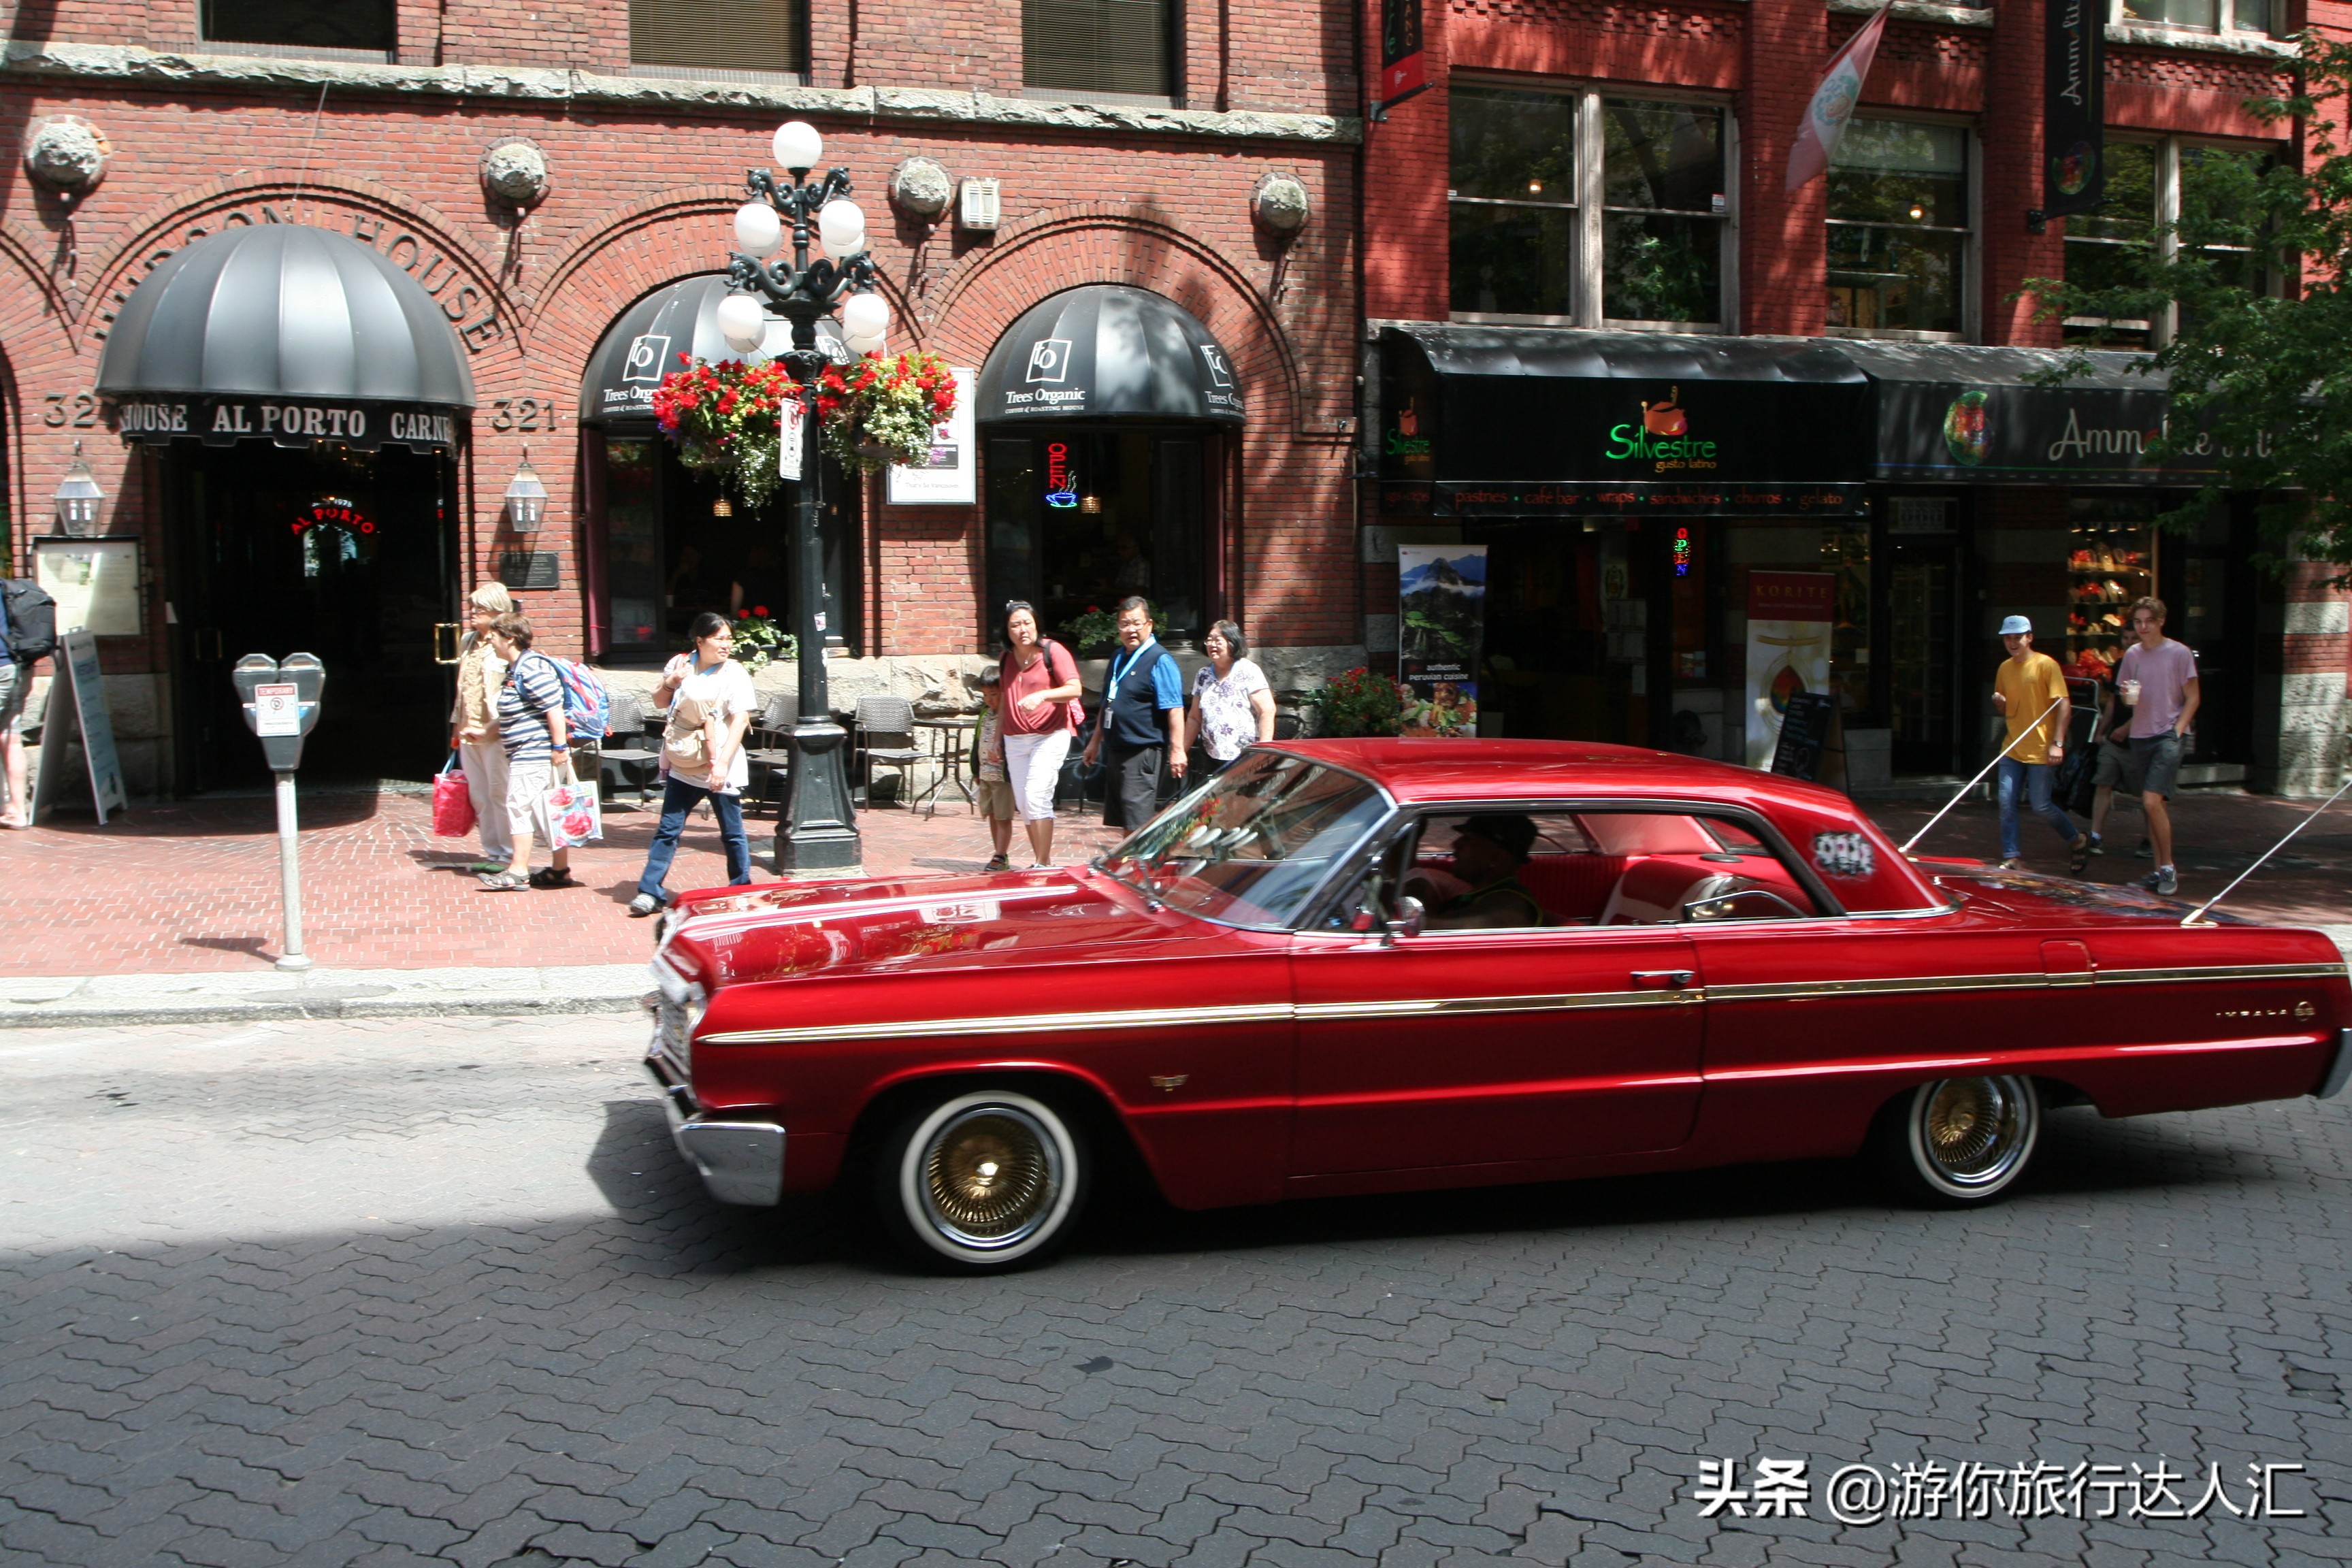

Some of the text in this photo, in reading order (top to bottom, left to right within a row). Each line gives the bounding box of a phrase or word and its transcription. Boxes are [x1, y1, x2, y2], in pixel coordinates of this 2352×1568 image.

[354, 214, 504, 353] HOUSE
[604, 389, 629, 402] Trees
[1006, 388, 1085, 405] Trees Organic
[212, 406, 252, 432] AL
[261, 406, 365, 438] PORTO
[492, 397, 557, 431] 321
[1047, 442, 1068, 489] OPEN
[1654, 458, 1717, 473] gusto latino
[1454, 485, 1844, 511] pastries café bar wraps sandwiches churros gelato
[291, 508, 376, 536] AL PORTO
[1675, 527, 1689, 576] OPEN
[1755, 585, 1828, 599] KORITE
[1426, 663, 1461, 672] authentic
[1443, 672, 1469, 681] cuisine
